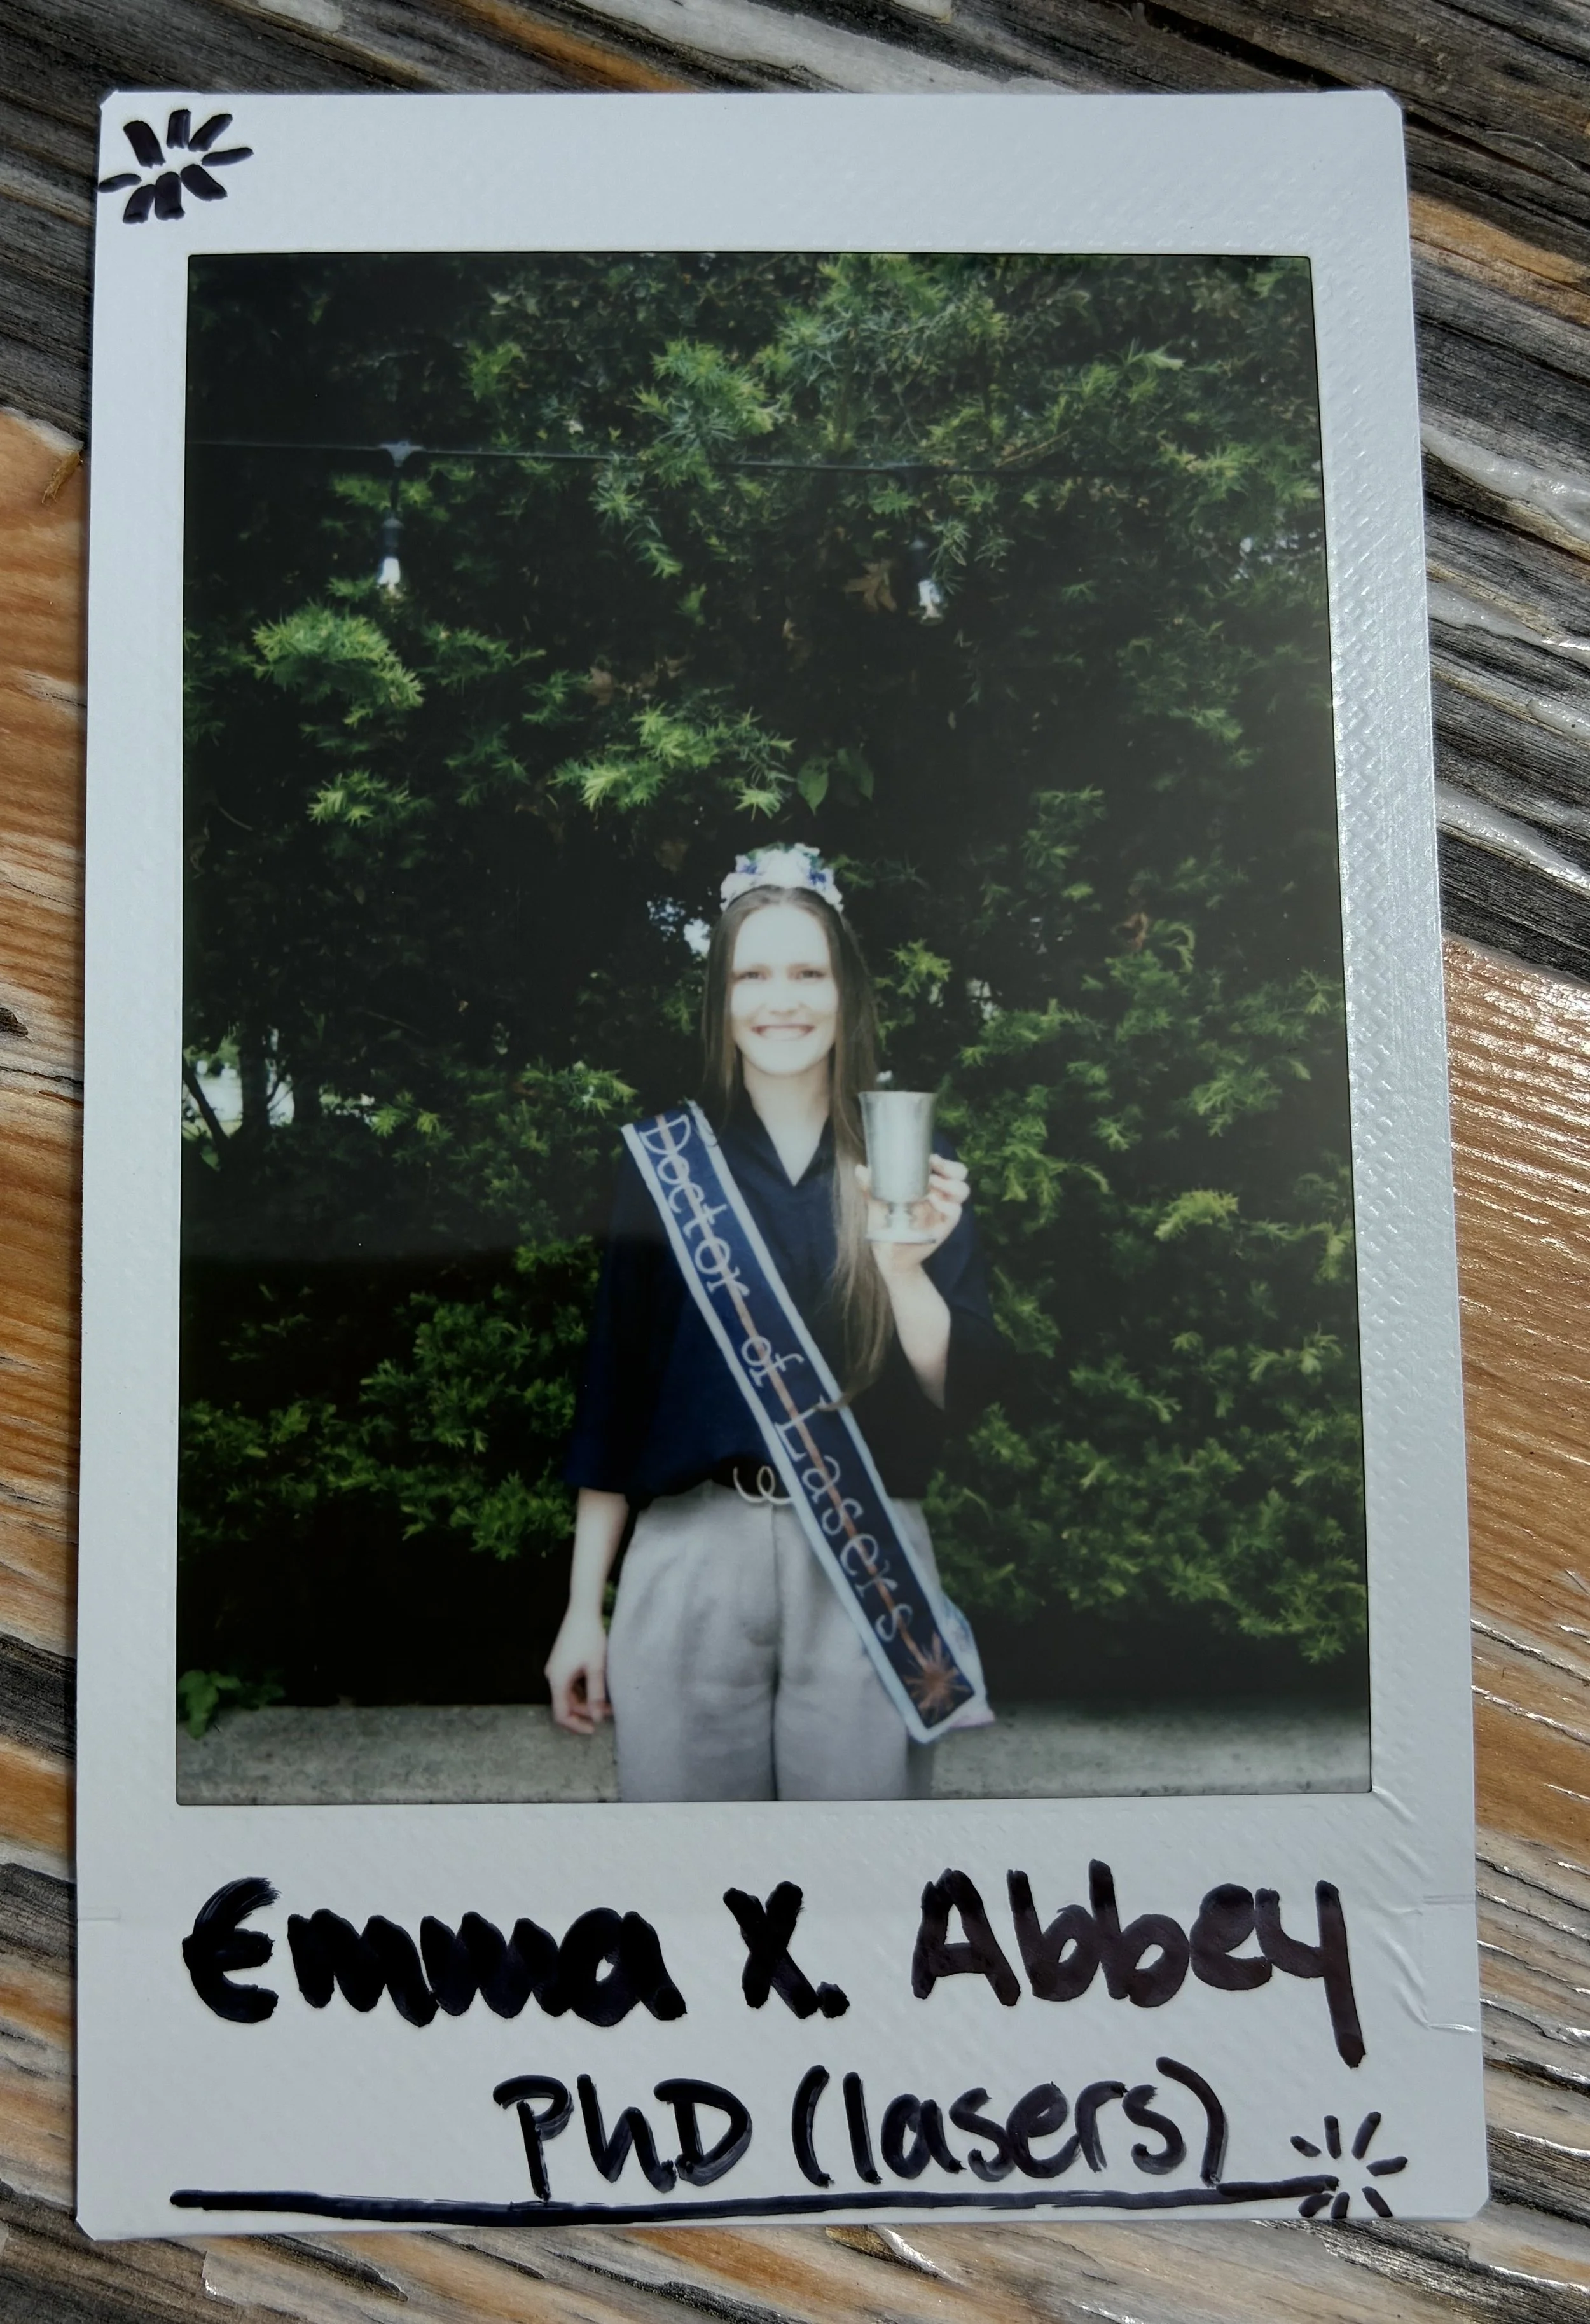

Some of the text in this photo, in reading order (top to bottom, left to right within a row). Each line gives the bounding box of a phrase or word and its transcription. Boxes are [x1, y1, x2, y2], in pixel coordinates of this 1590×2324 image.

[639, 1114, 914, 1642] Doctor of Lasers
[181, 1858, 1367, 2070] Emma X. Abbey
[791, 2056, 1228, 2188] (lasers)
